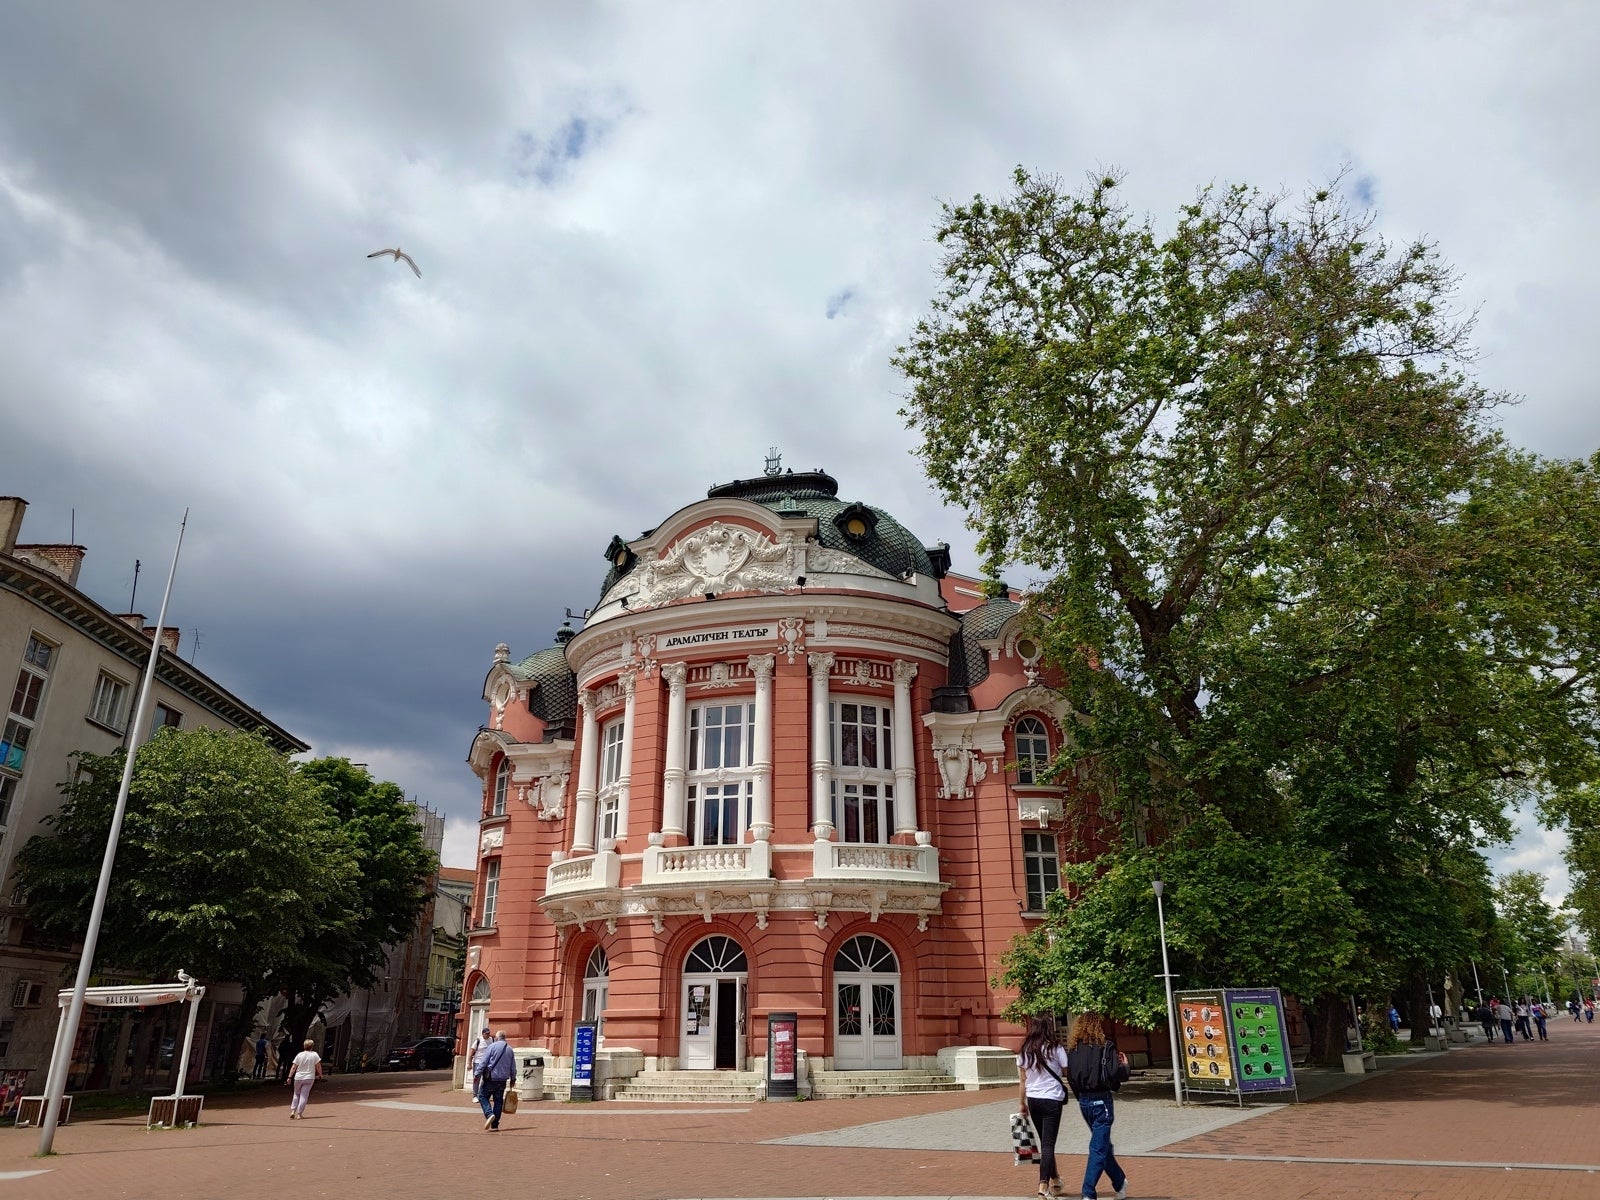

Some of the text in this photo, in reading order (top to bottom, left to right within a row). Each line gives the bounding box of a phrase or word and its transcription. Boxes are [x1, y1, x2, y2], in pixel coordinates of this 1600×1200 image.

[666, 628, 769, 647] ДРАМАТИЧЕН ТЕАТЪР
[106, 995, 139, 1004] PALERMO
